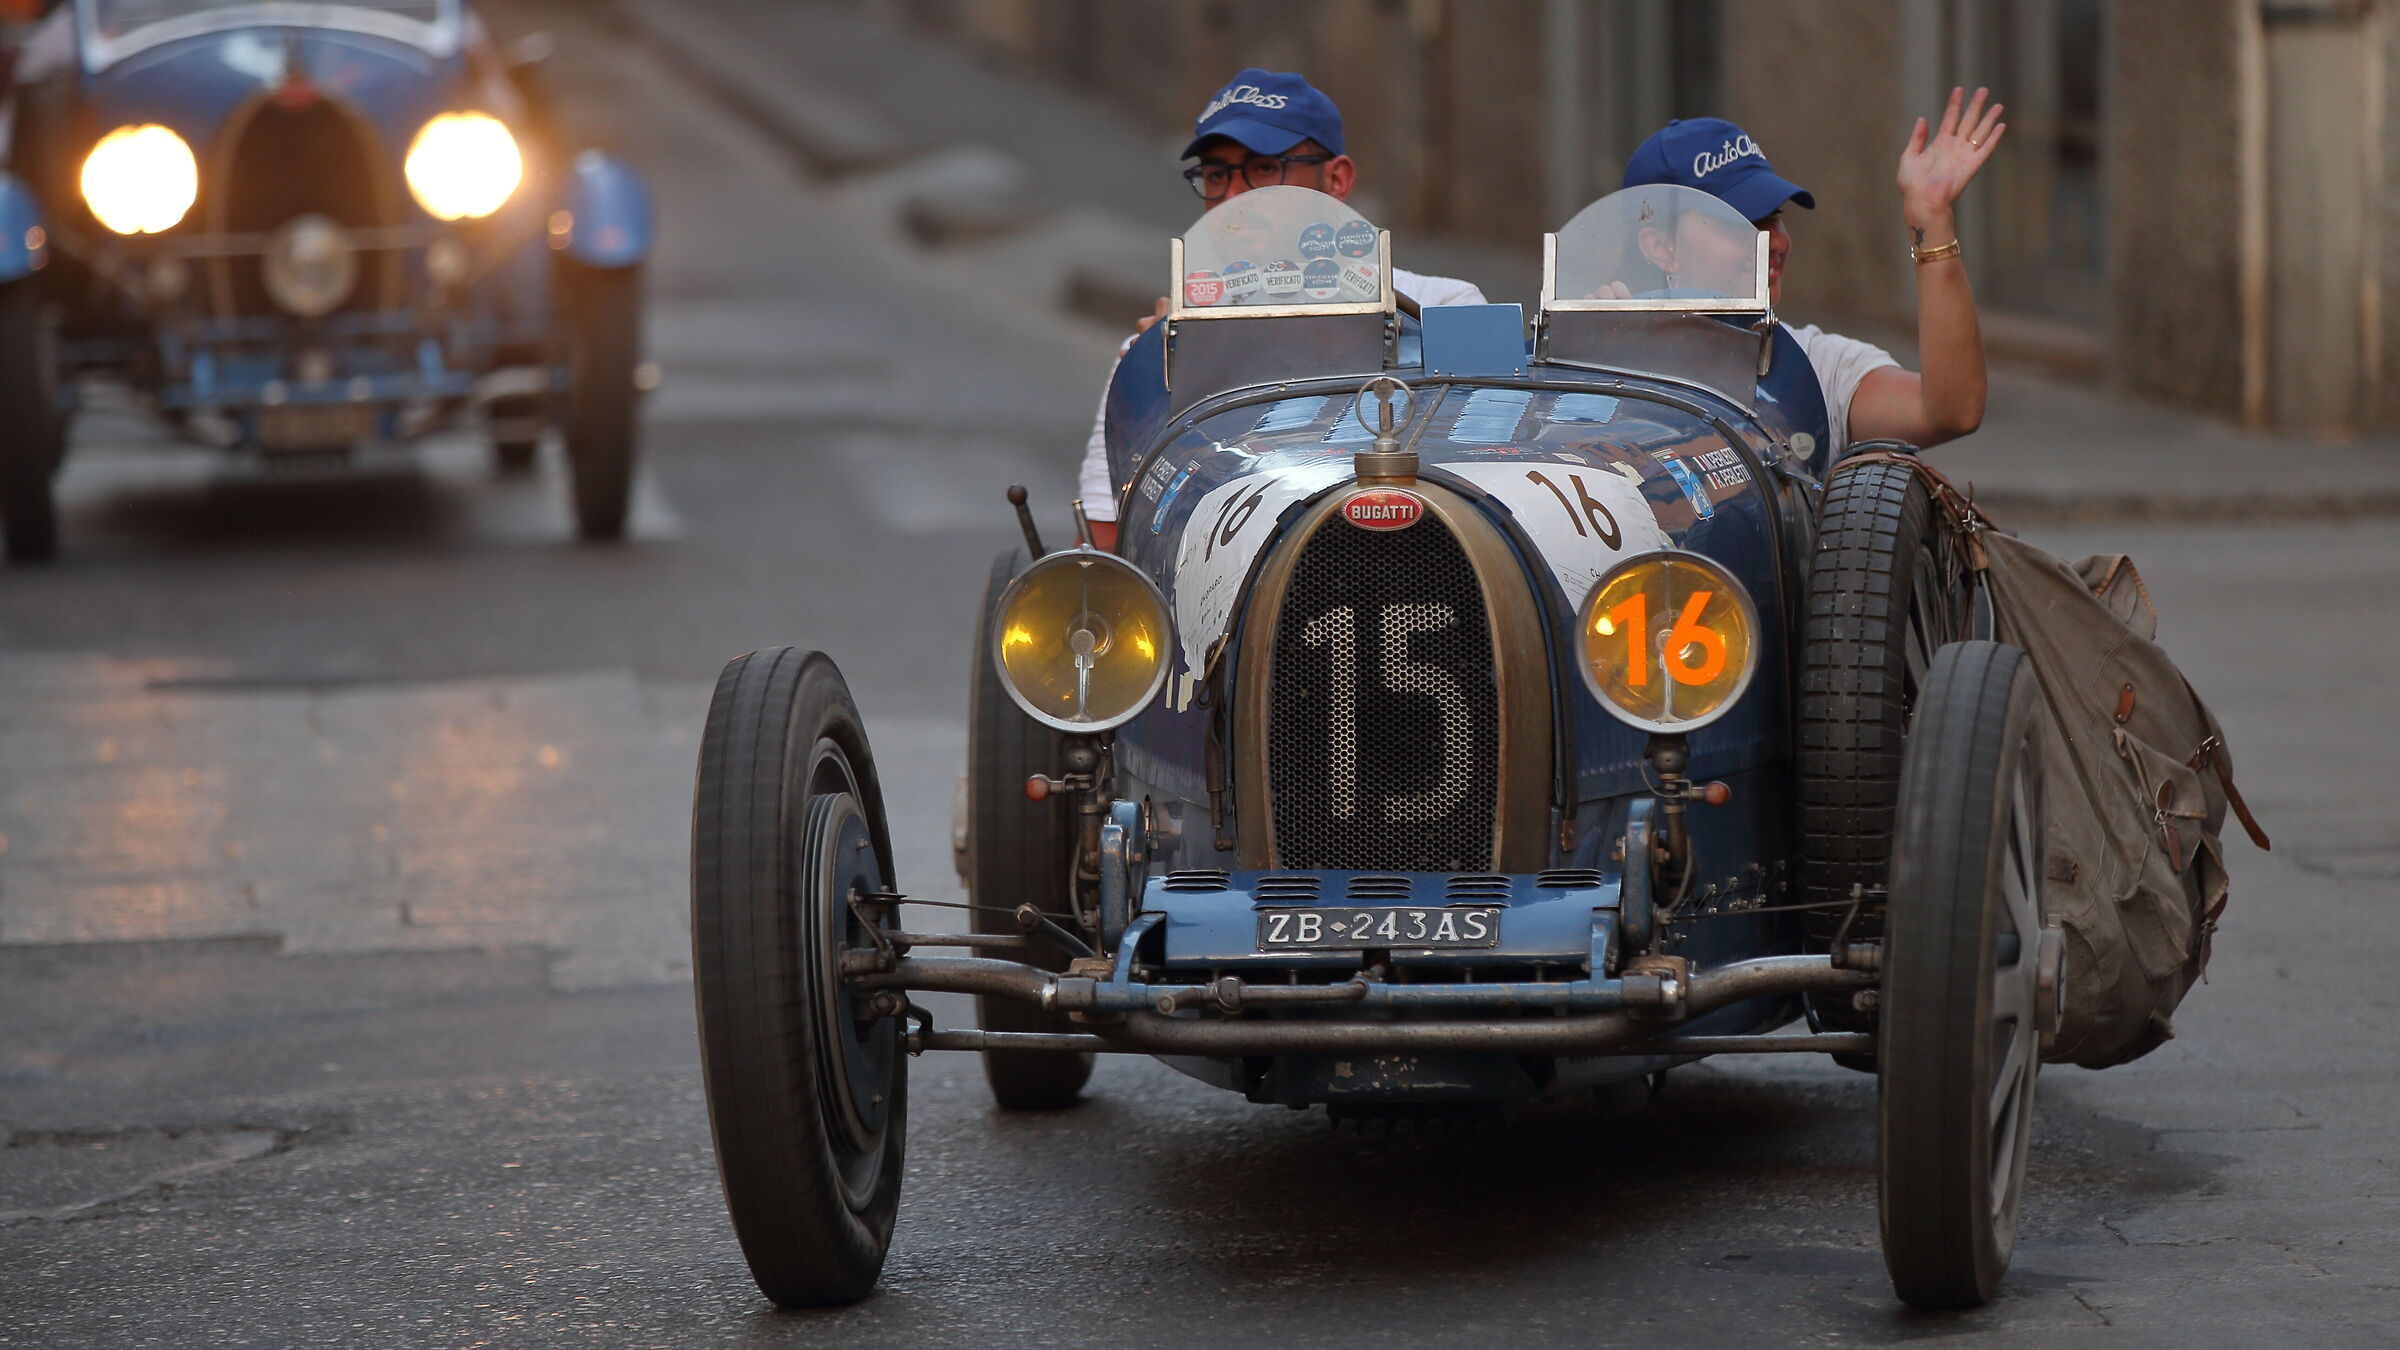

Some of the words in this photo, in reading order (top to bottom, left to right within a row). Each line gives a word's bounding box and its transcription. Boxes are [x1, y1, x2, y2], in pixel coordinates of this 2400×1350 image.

[1191, 283, 1218, 296] 2015
[1266, 274, 1302, 286] VERIFICATO
[1205, 474, 1287, 564] 16
[1351, 504, 1414, 521] BUGATTI
[1525, 470, 1623, 552] 16
[1609, 591, 1726, 687] 16
[1301, 602, 1474, 823] 15
